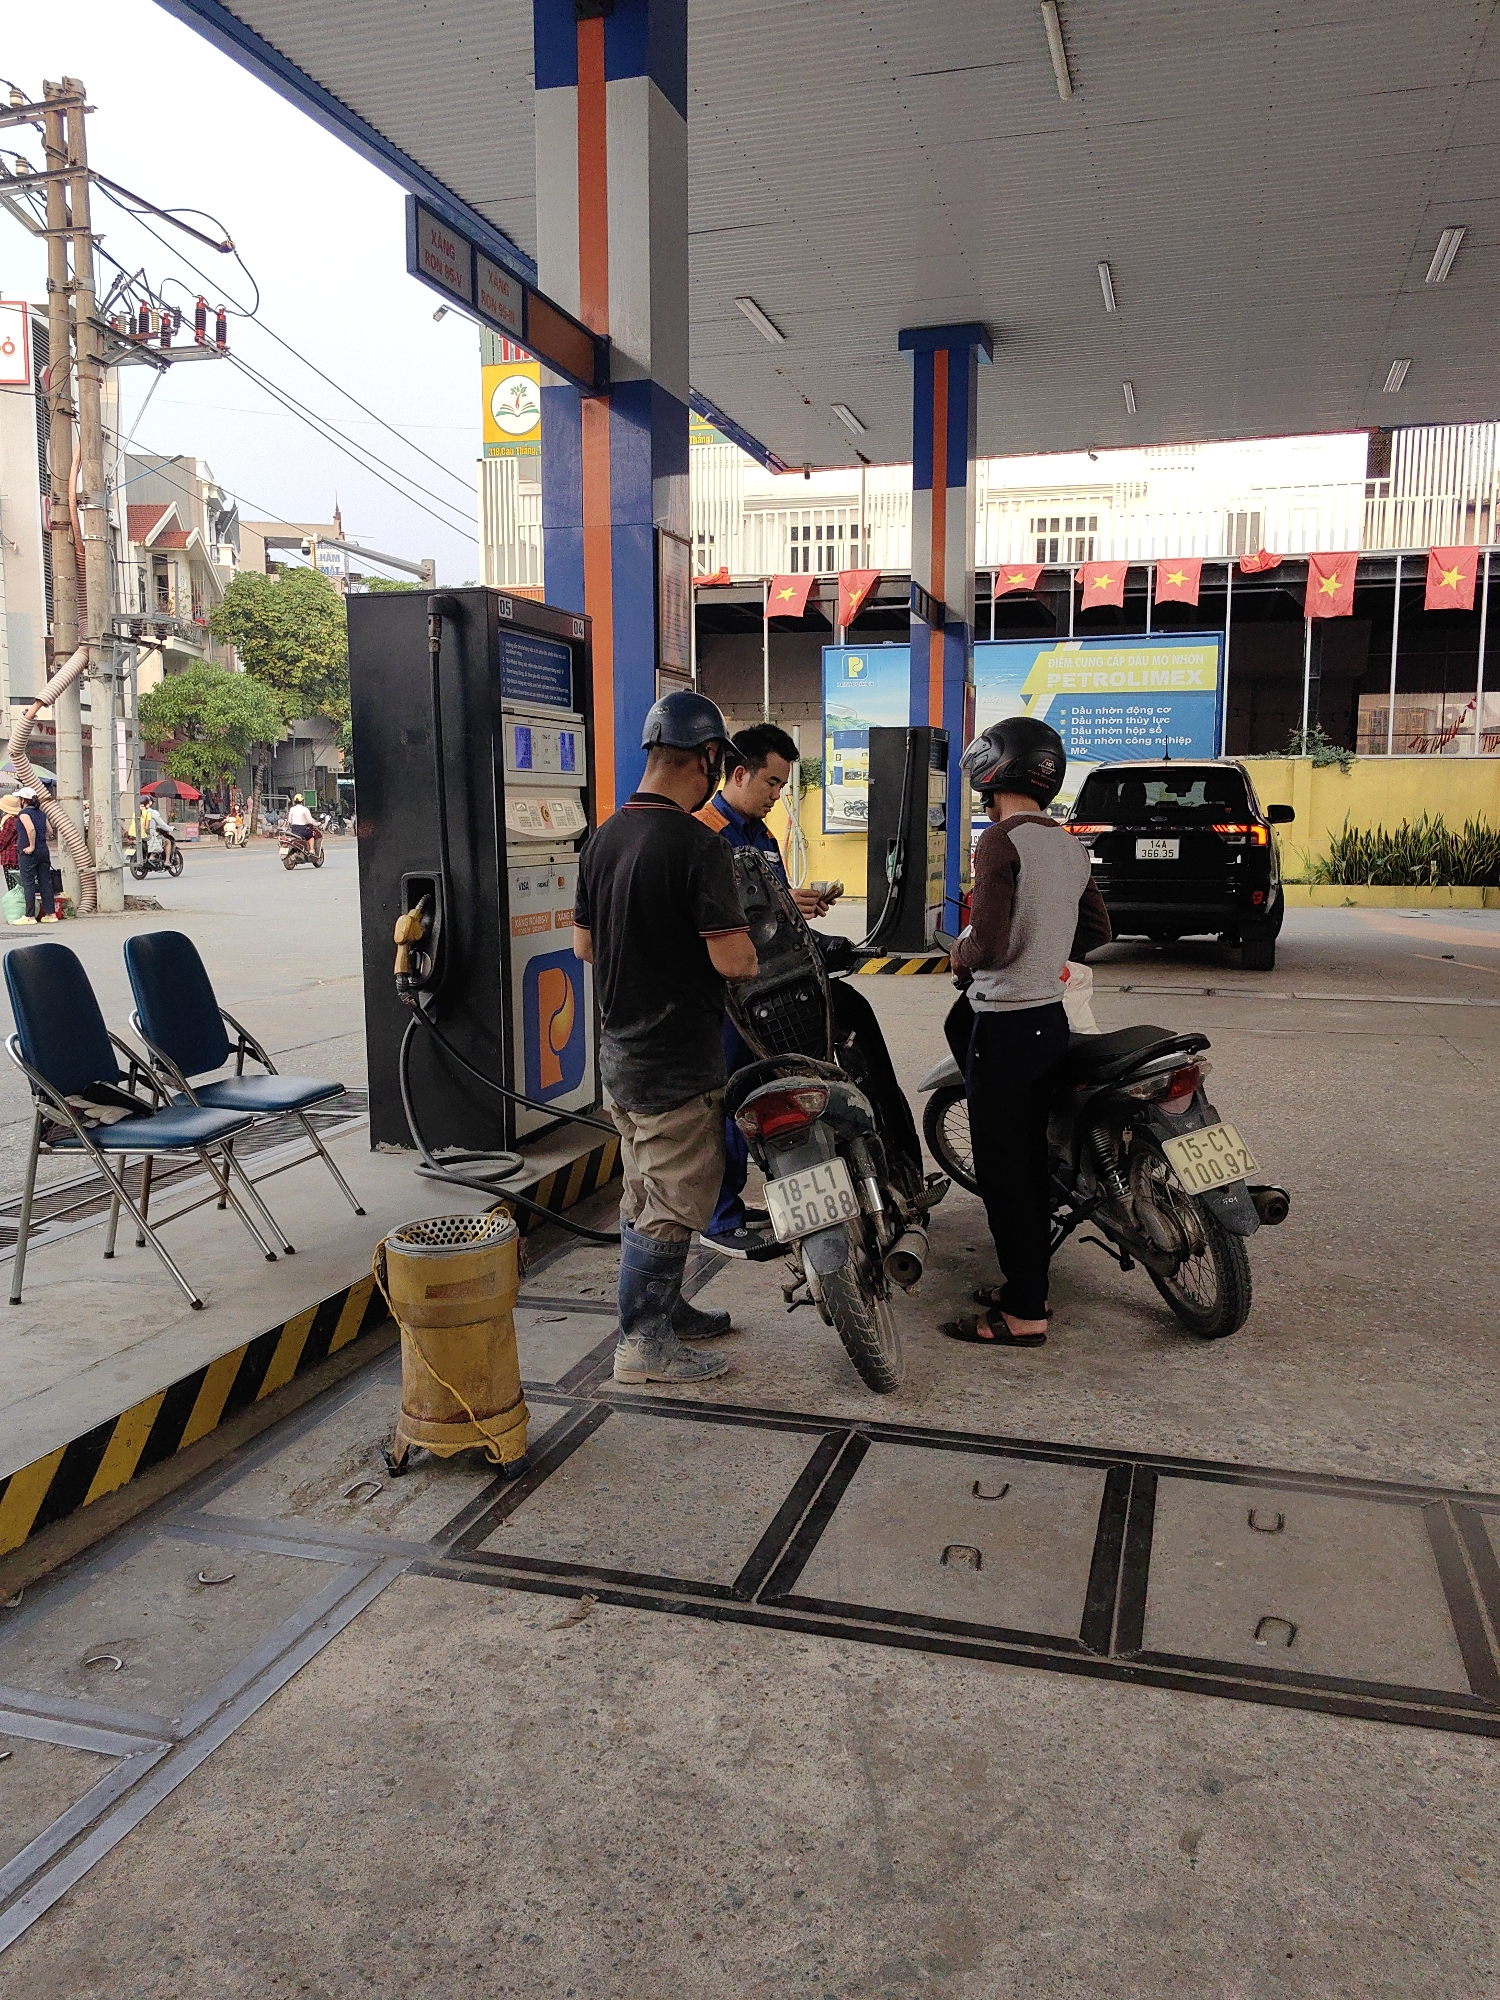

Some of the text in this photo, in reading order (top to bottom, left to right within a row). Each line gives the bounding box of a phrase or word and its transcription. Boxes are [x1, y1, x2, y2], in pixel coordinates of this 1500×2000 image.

[424, 249, 443, 275] RON
[481, 289, 497, 314] RON
[500, 600, 511, 617] 05
[573, 620, 583, 636] 04
[1048, 656, 1072, 668] ĐIỂM
[1075, 657, 1104, 668] CUNG
[1106, 653, 1126, 667] CẤP
[1127, 653, 1149, 667] DẦU
[1172, 653, 1204, 665] NHỜN
[1047, 670, 1203, 688] PETROLIMEX
[1071, 706, 1092, 715] Dầu
[1095, 706, 1123, 715] nhờn
[1126, 706, 1154, 716] động
[1071, 716, 1092, 725] Dầu
[1095, 717, 1123, 725] nhờn
[1153, 716, 1171, 725] lực
[1071, 726, 1092, 735] Dầu
[1125, 726, 1146, 736] hộp
[1149, 725, 1162, 734] số
[1070, 736, 1092, 745] Dầu
[1125, 737, 1152, 745] công
[1155, 736, 1192, 746] nghiệp
[1150, 840, 1167, 849] 14A
[1141, 849, 1174, 858] 366.35
[1177, 1127, 1234, 1163] 15-C1
[1183, 1148, 1255, 1189] 100.92
[777, 1165, 837, 1206] 18-L1
